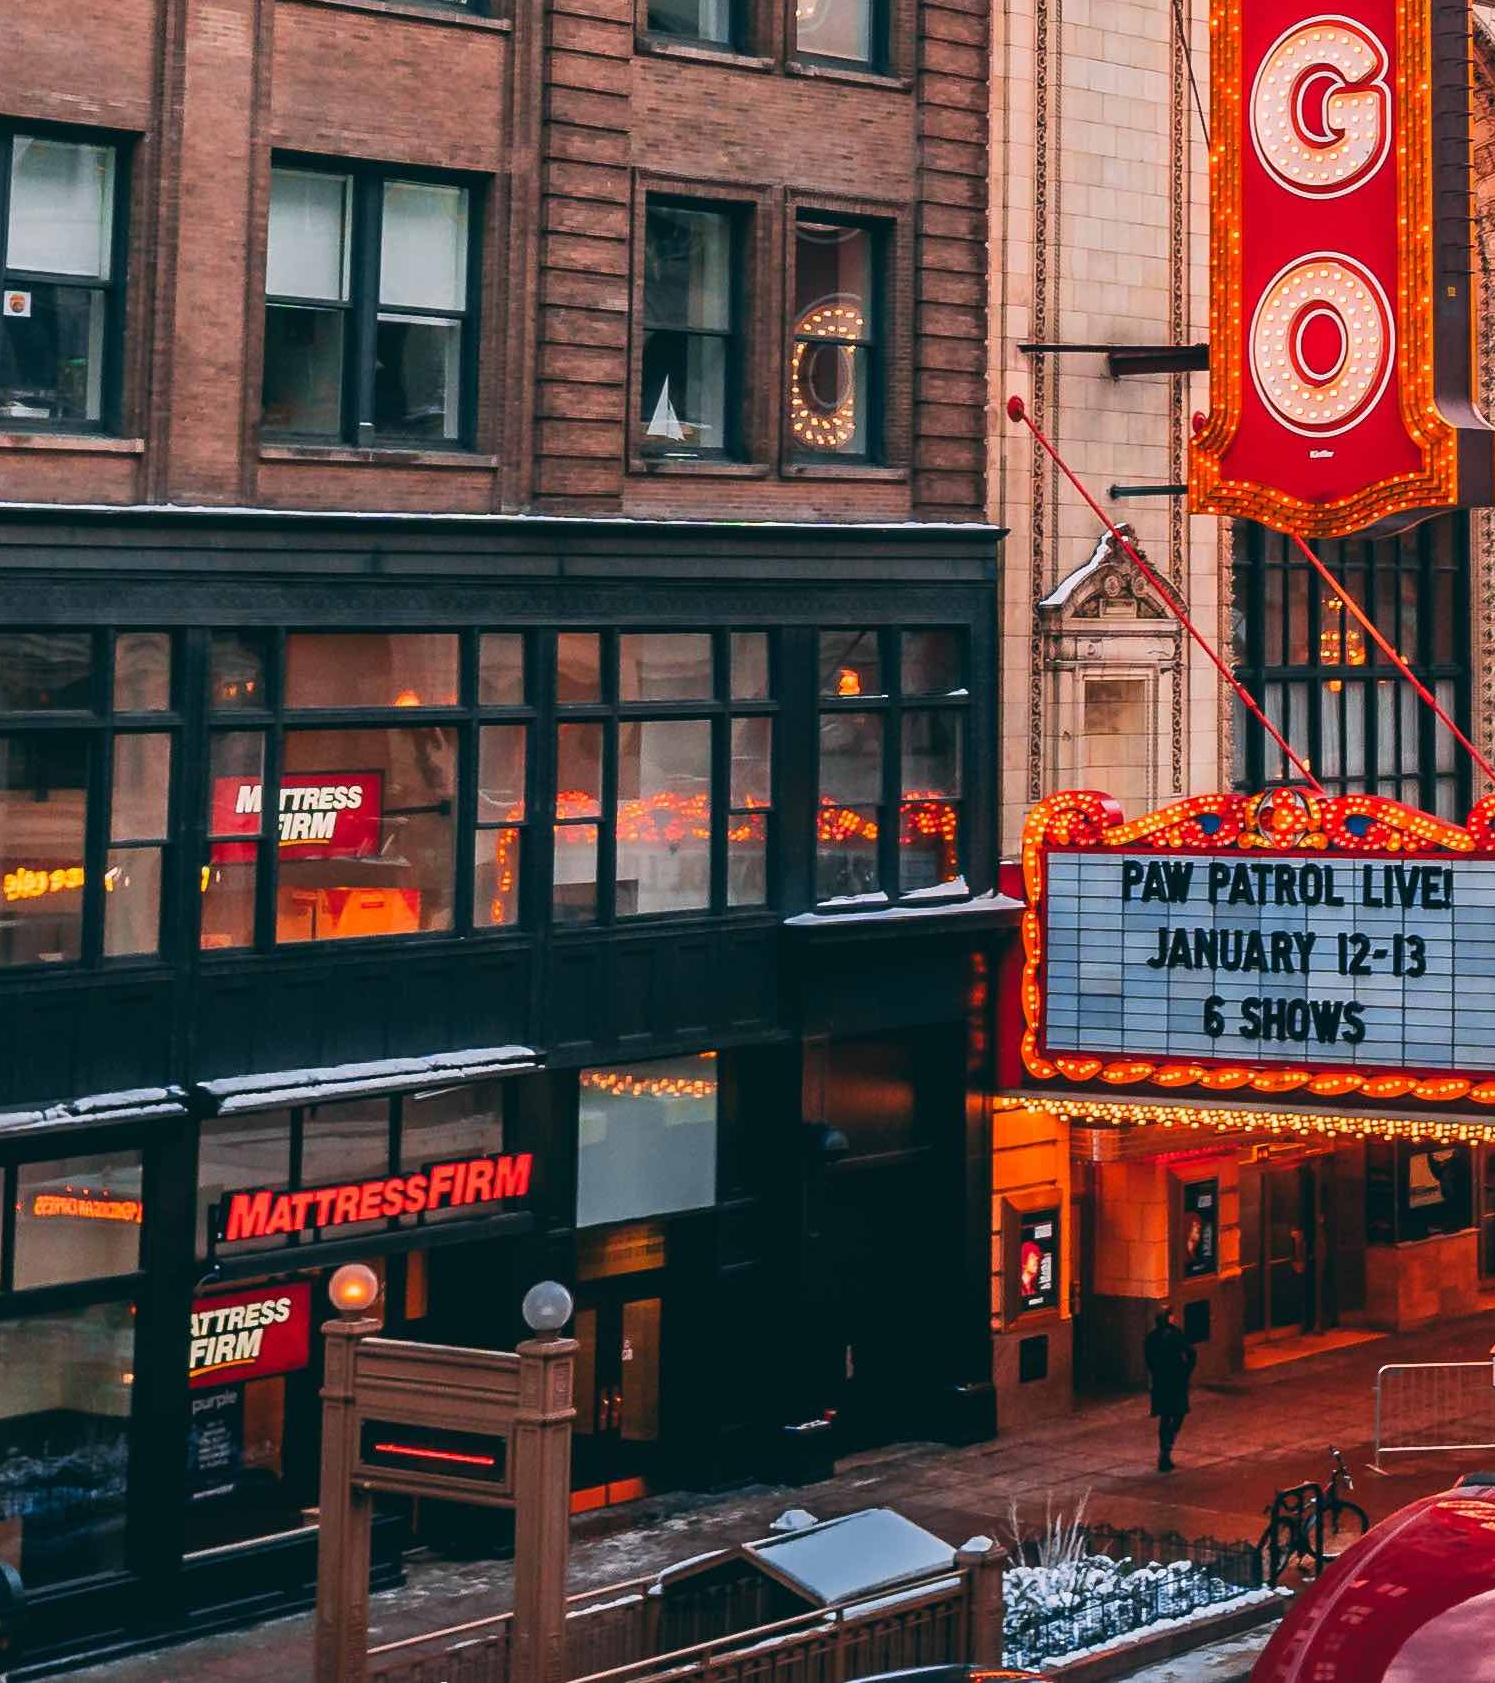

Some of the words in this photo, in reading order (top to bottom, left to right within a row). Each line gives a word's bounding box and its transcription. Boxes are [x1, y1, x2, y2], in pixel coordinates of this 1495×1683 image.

[236, 785, 363, 814] MTTRESS
[1122, 861, 1194, 904] PAW
[1209, 863, 1345, 907] PATROL
[1363, 864, 1453, 910] LIVE!
[1146, 928, 1316, 976] JANUARY
[1338, 932, 1426, 978] 12-13
[1203, 995, 1226, 1039] 6
[1240, 999, 1367, 1045] SHOWS
[189, 1328, 263, 1369] FIRM
[192, 1390, 238, 1415] purple
